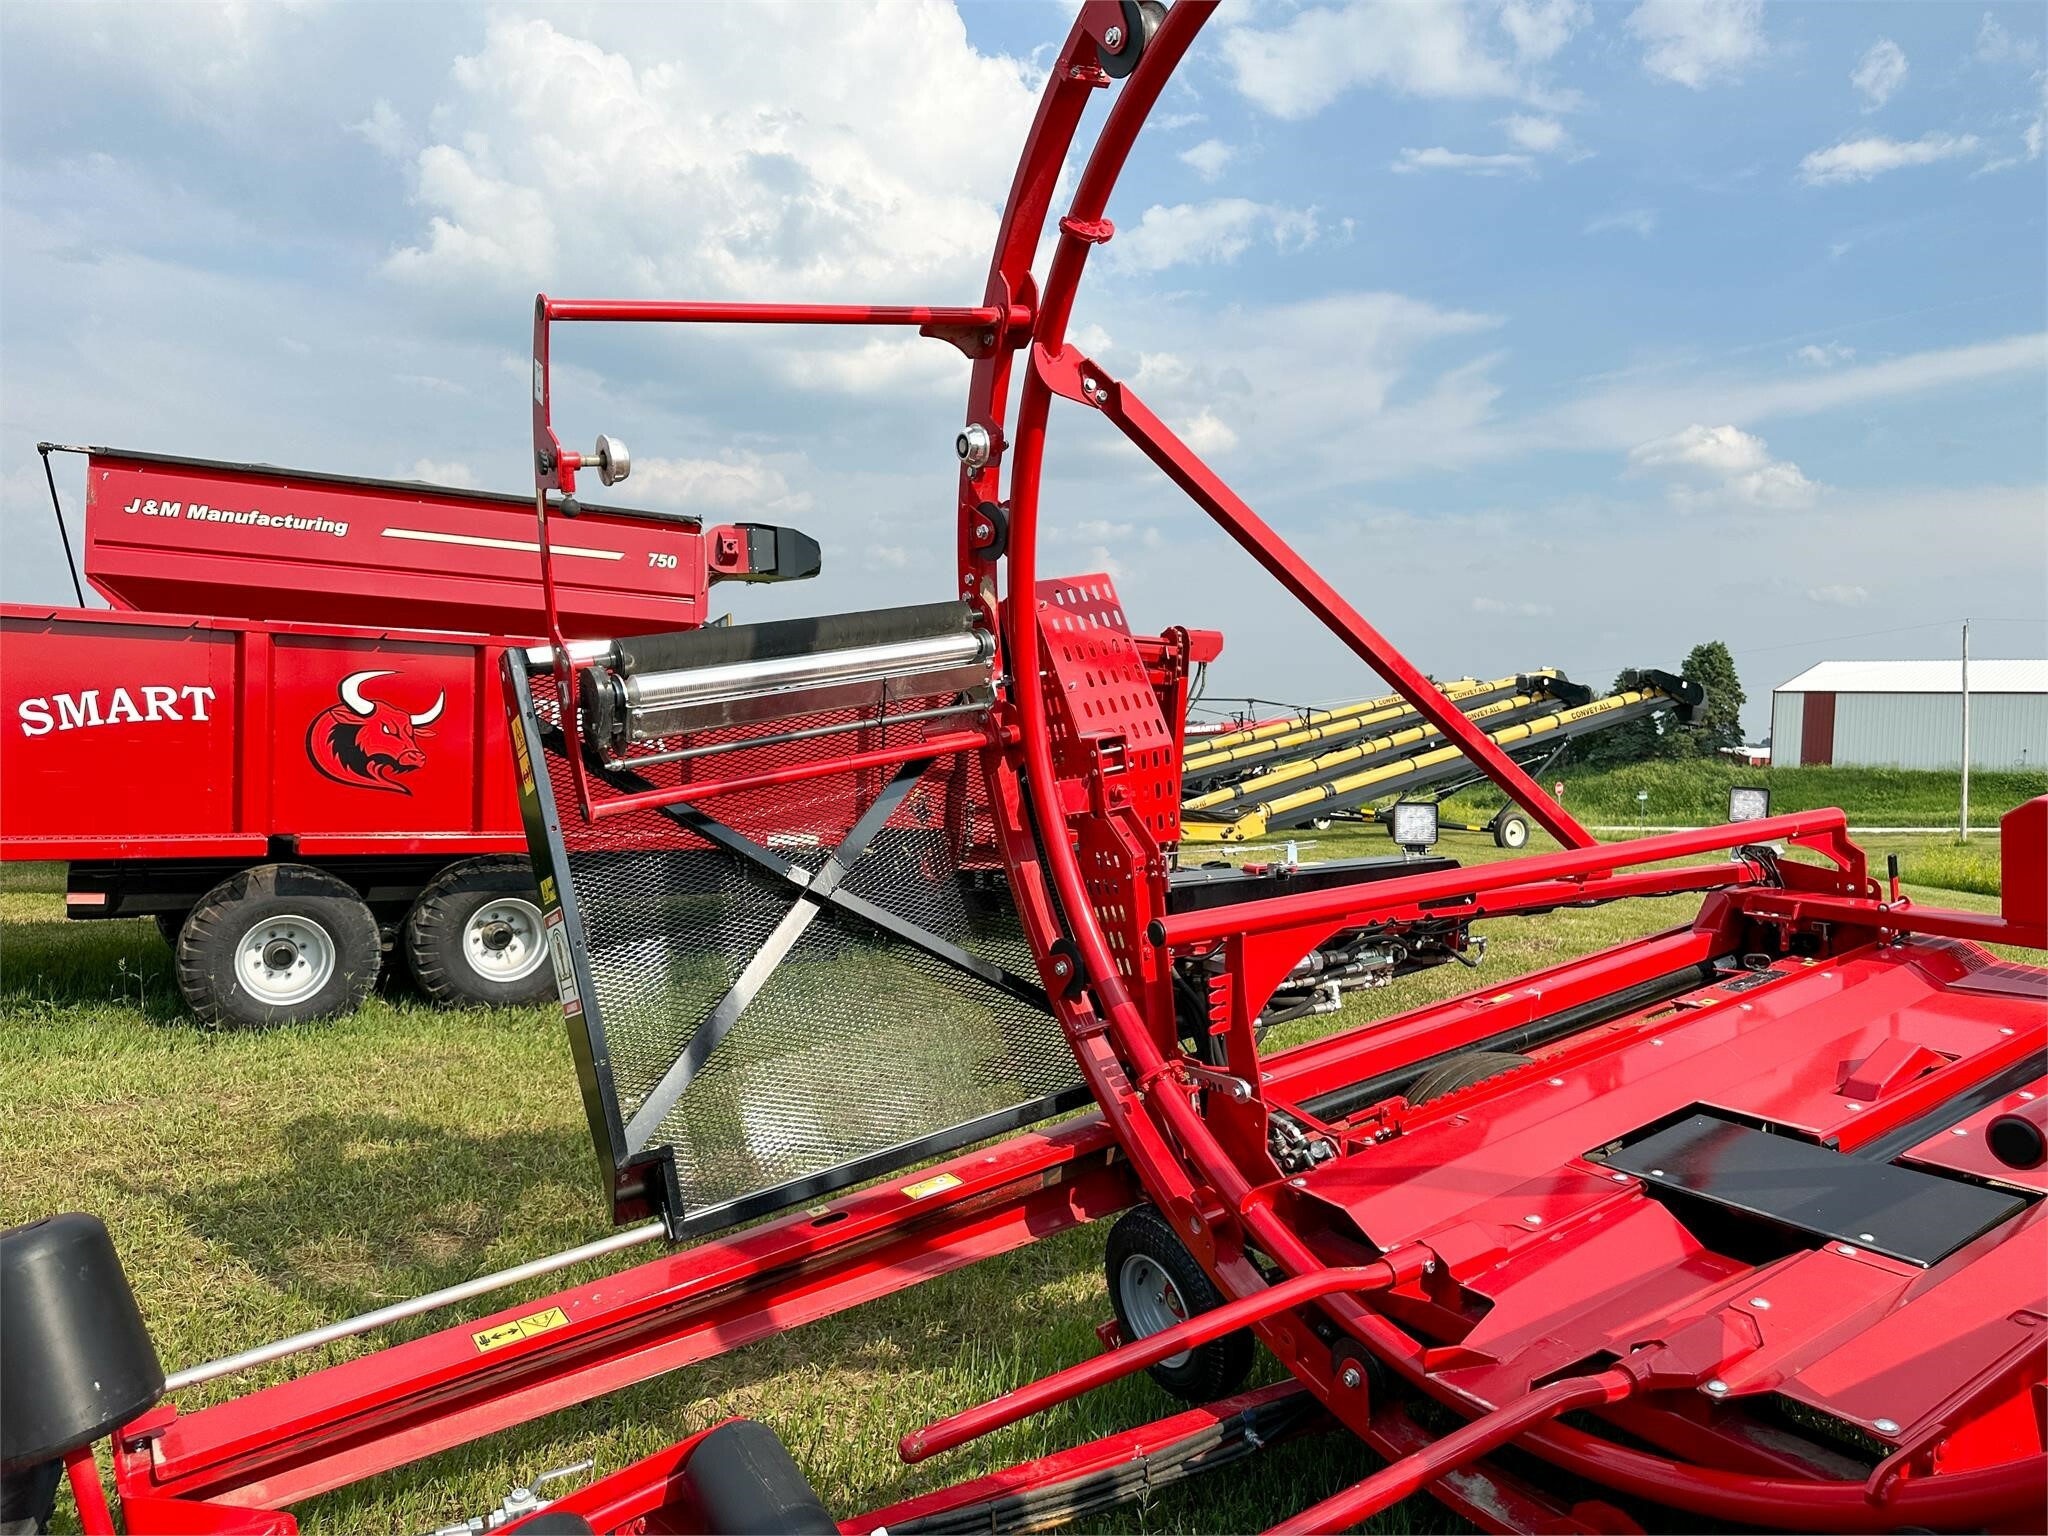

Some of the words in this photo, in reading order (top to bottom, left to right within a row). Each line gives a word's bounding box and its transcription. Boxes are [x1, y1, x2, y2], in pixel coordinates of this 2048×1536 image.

[124, 498, 182, 517] J&M
[186, 504, 349, 537] Manufacturing
[647, 552, 677, 569] 750
[18, 685, 217, 737] SMART
